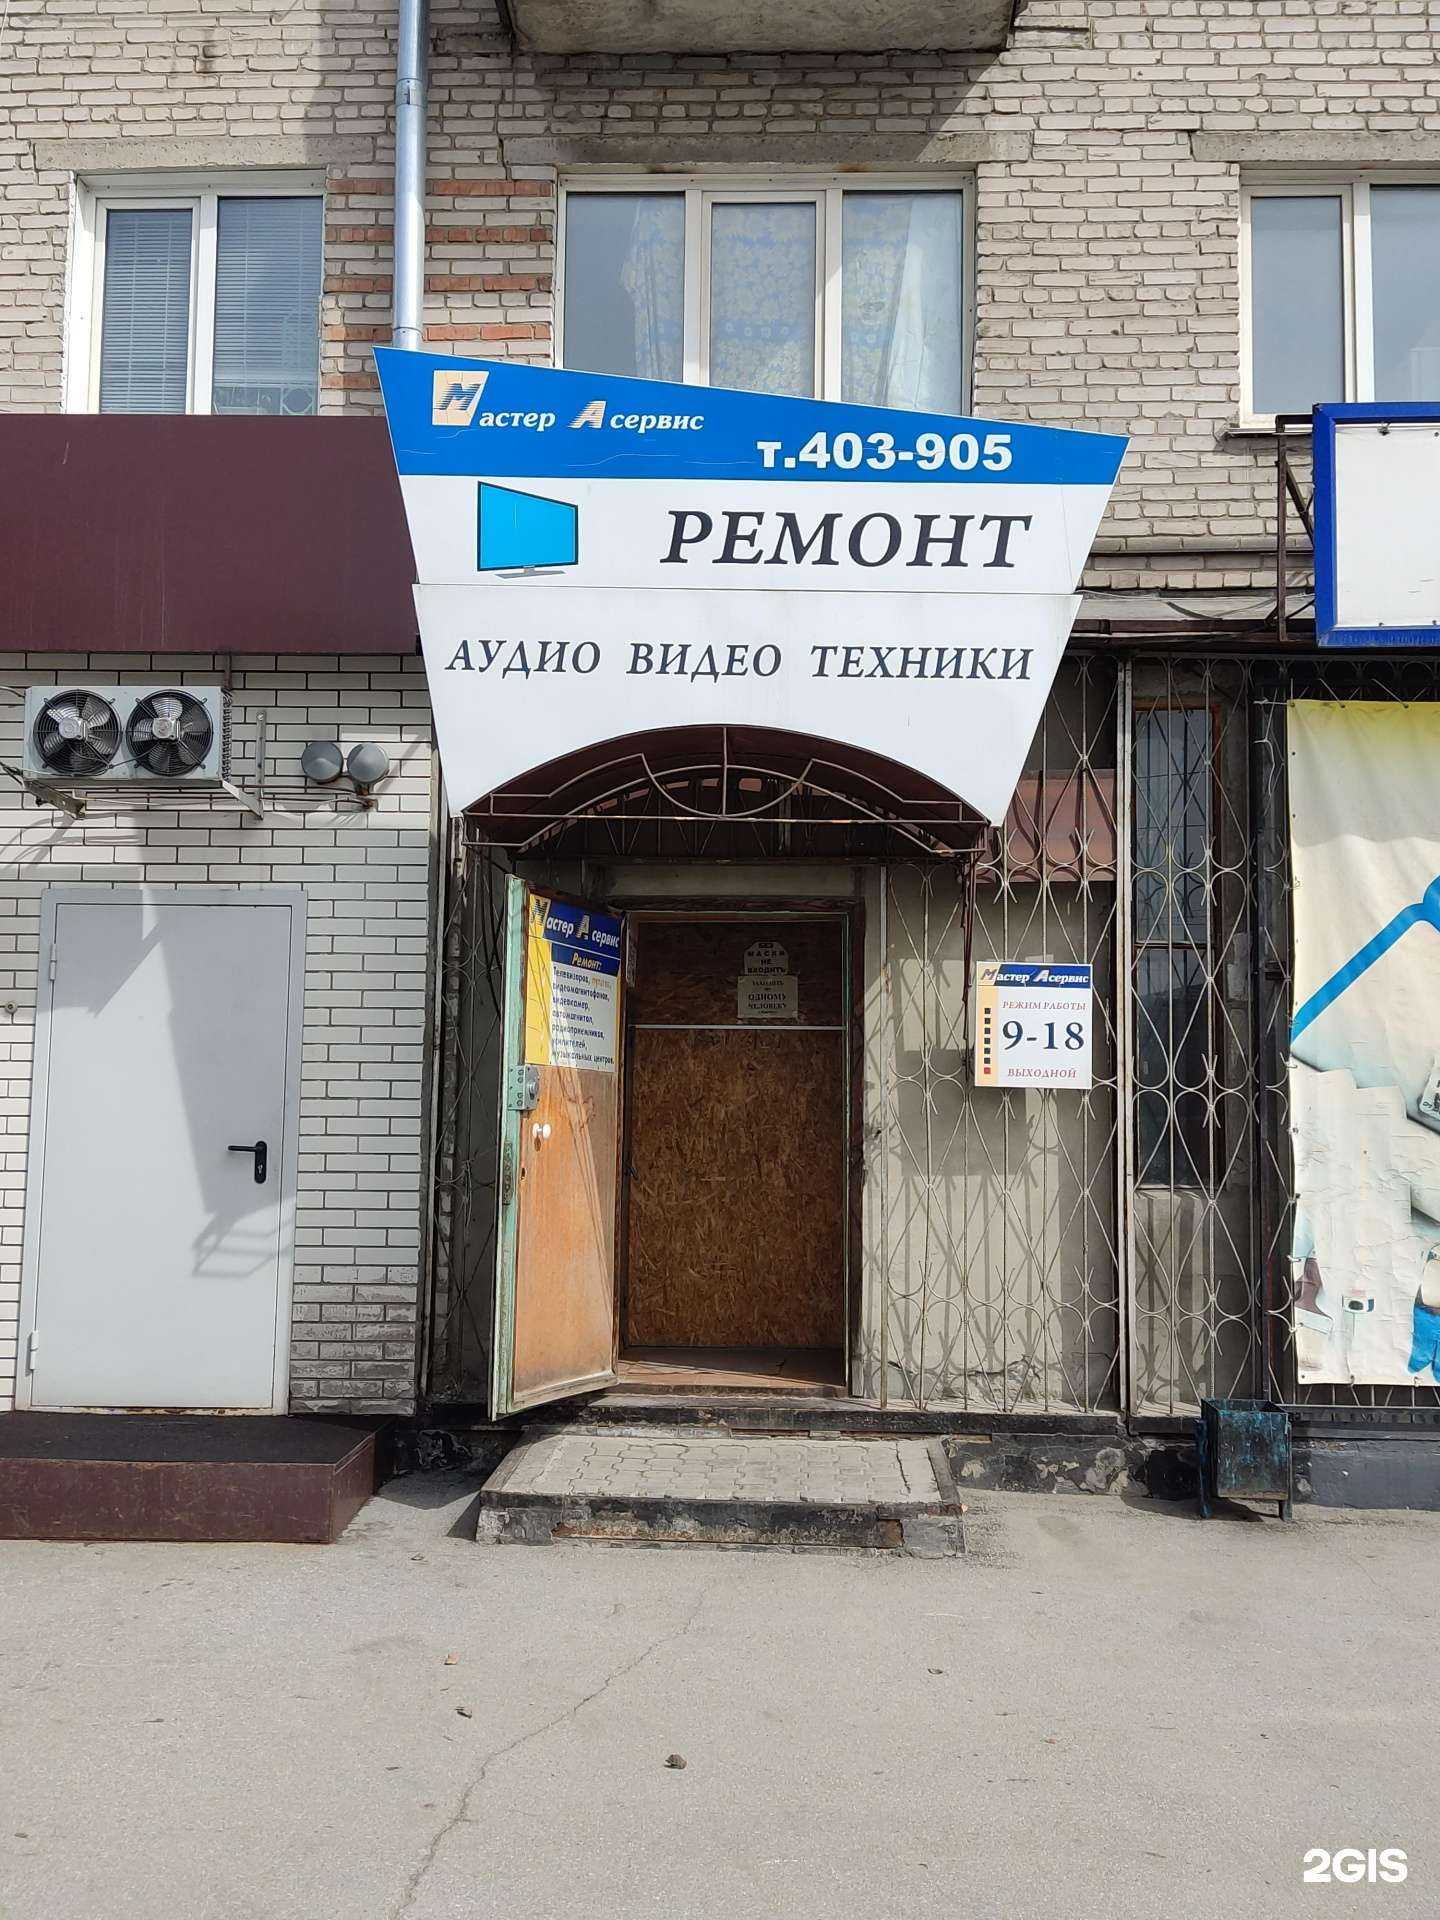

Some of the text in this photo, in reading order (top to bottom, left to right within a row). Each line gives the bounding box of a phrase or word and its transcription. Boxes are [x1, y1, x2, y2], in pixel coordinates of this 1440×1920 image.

[434, 382, 556, 431] Мастер
[757, 432, 1013, 472] т.403-905
[660, 509, 1033, 569] РЕМОНТ
[444, 639, 1034, 684] АУДИО ВИДЕО ТЕХНИКИ
[981, 968, 1029, 983] Мастер
[1002, 1001, 1087, 1011] РЕЖИМ РАБОТЫ
[1002, 1020, 1085, 1051] 9-18
[1007, 1066, 1077, 1079] ВЫХОДНОЙ
